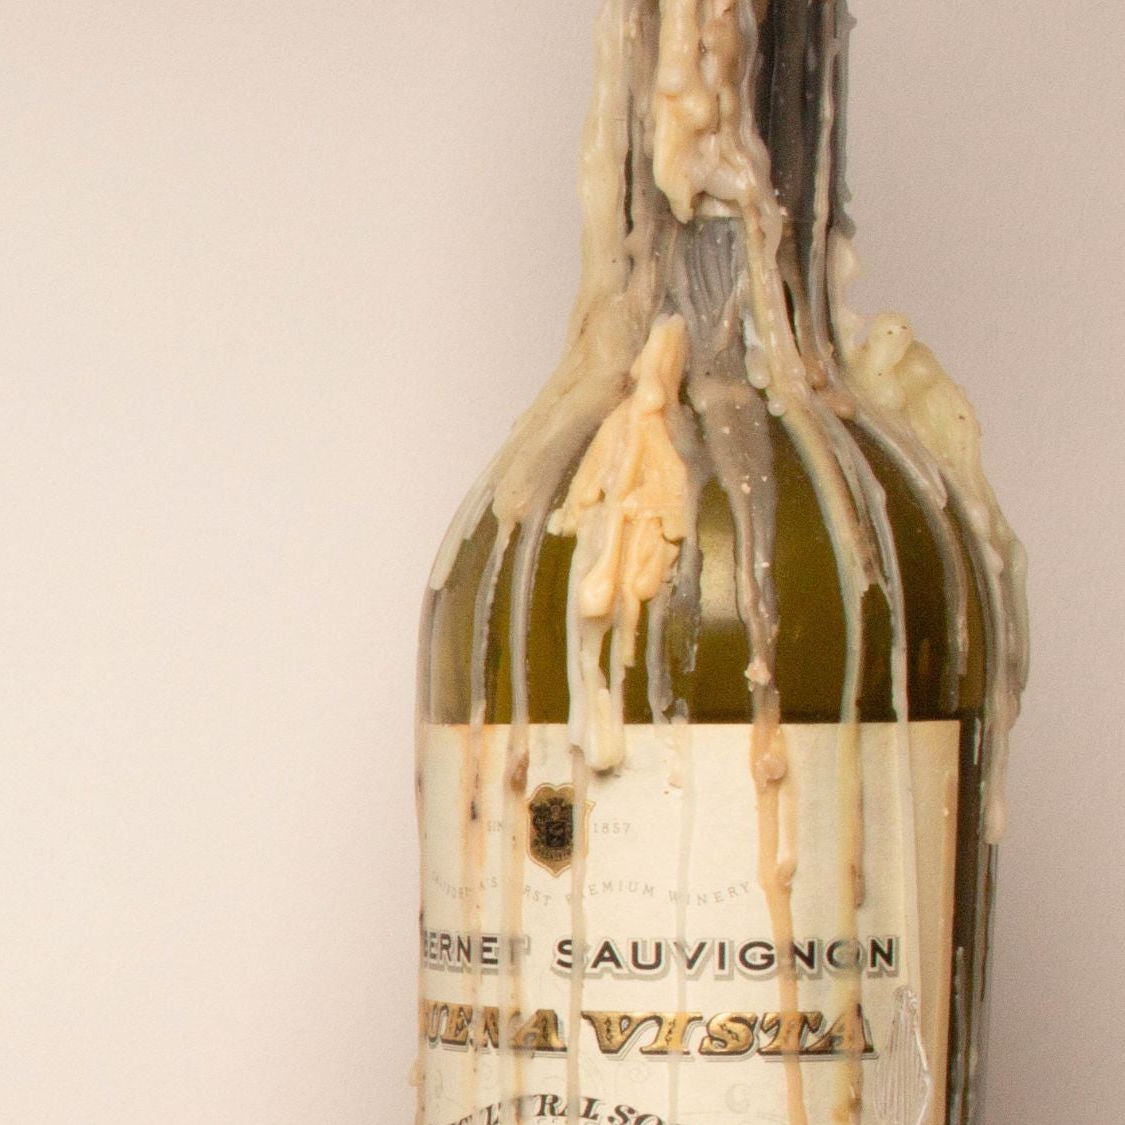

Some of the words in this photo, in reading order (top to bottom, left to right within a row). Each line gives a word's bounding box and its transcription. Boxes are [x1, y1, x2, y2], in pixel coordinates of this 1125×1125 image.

[593, 822, 632, 834] 1857
[566, 879, 655, 906] PEMIUM
[554, 936, 896, 974] SAUVIGNON
[580, 1010, 876, 1058] VISTA
